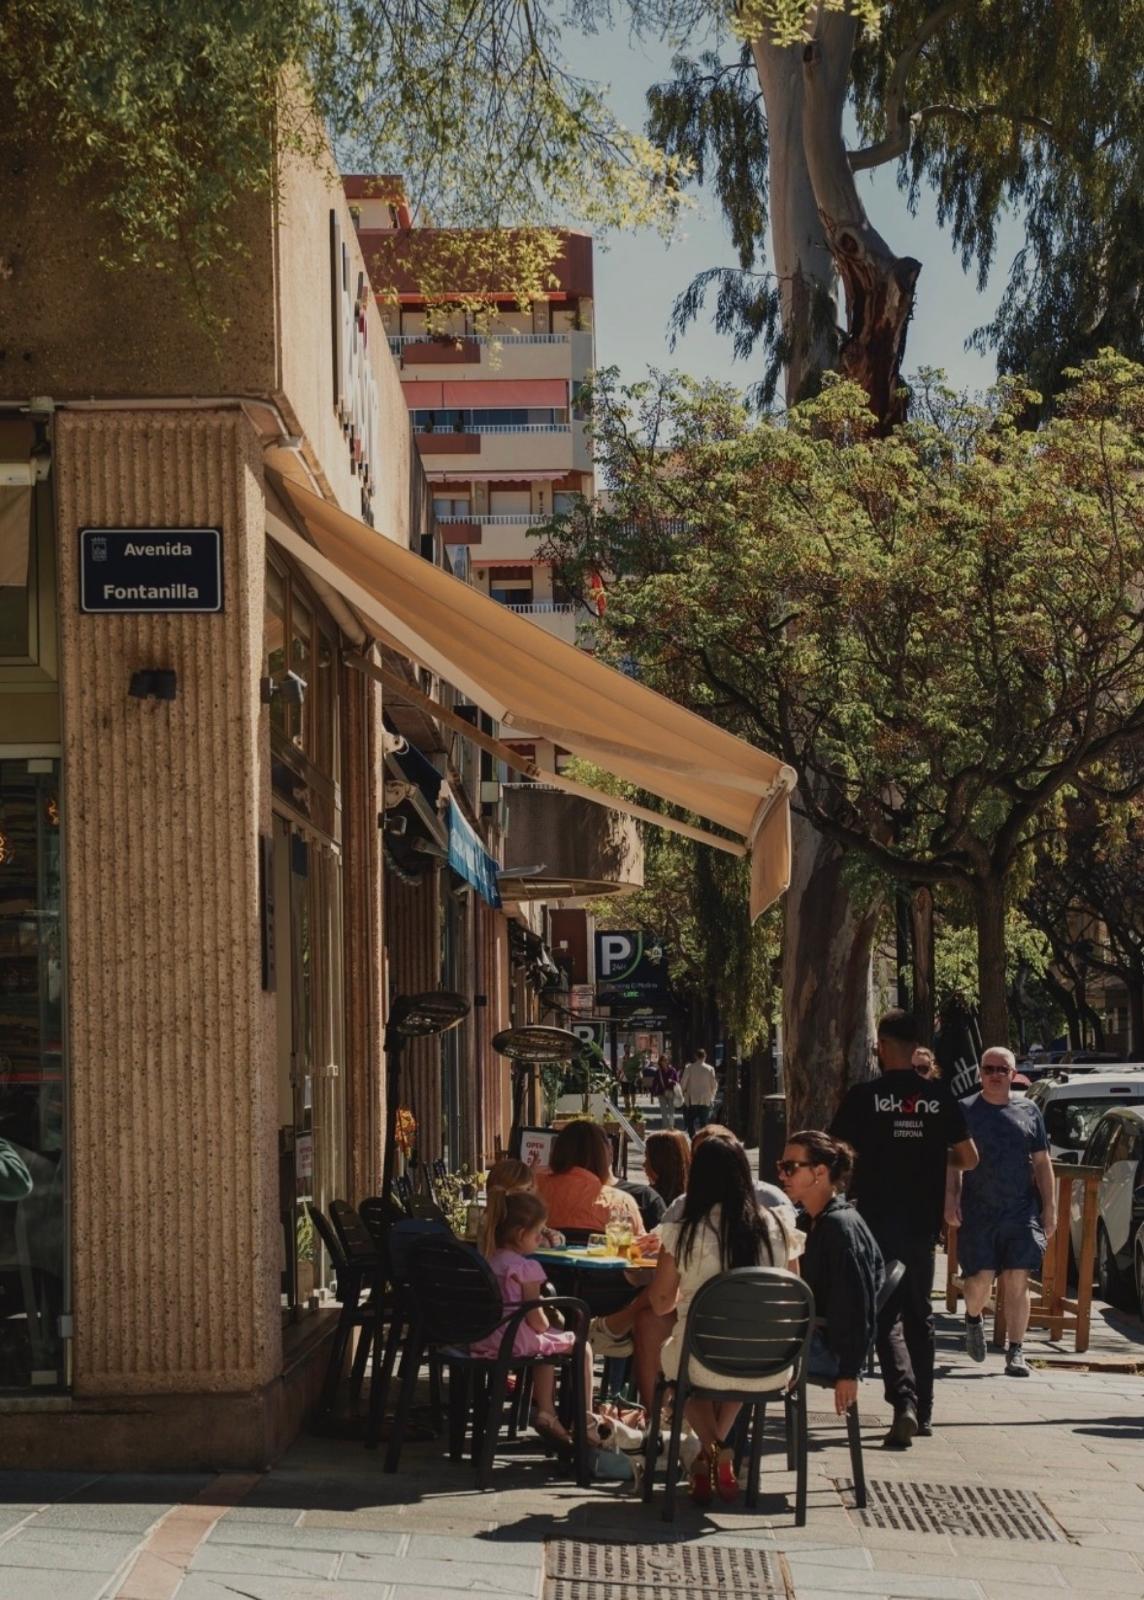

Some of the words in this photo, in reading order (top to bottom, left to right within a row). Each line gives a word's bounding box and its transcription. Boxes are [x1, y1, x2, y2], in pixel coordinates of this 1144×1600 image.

[124, 542, 192, 556] Avenida
[103, 584, 199, 600] Fontanilla
[601, 936, 631, 976] P
[893, 1120, 923, 1128] MARBELLA
[893, 1130, 923, 1138] ESTEPONA
